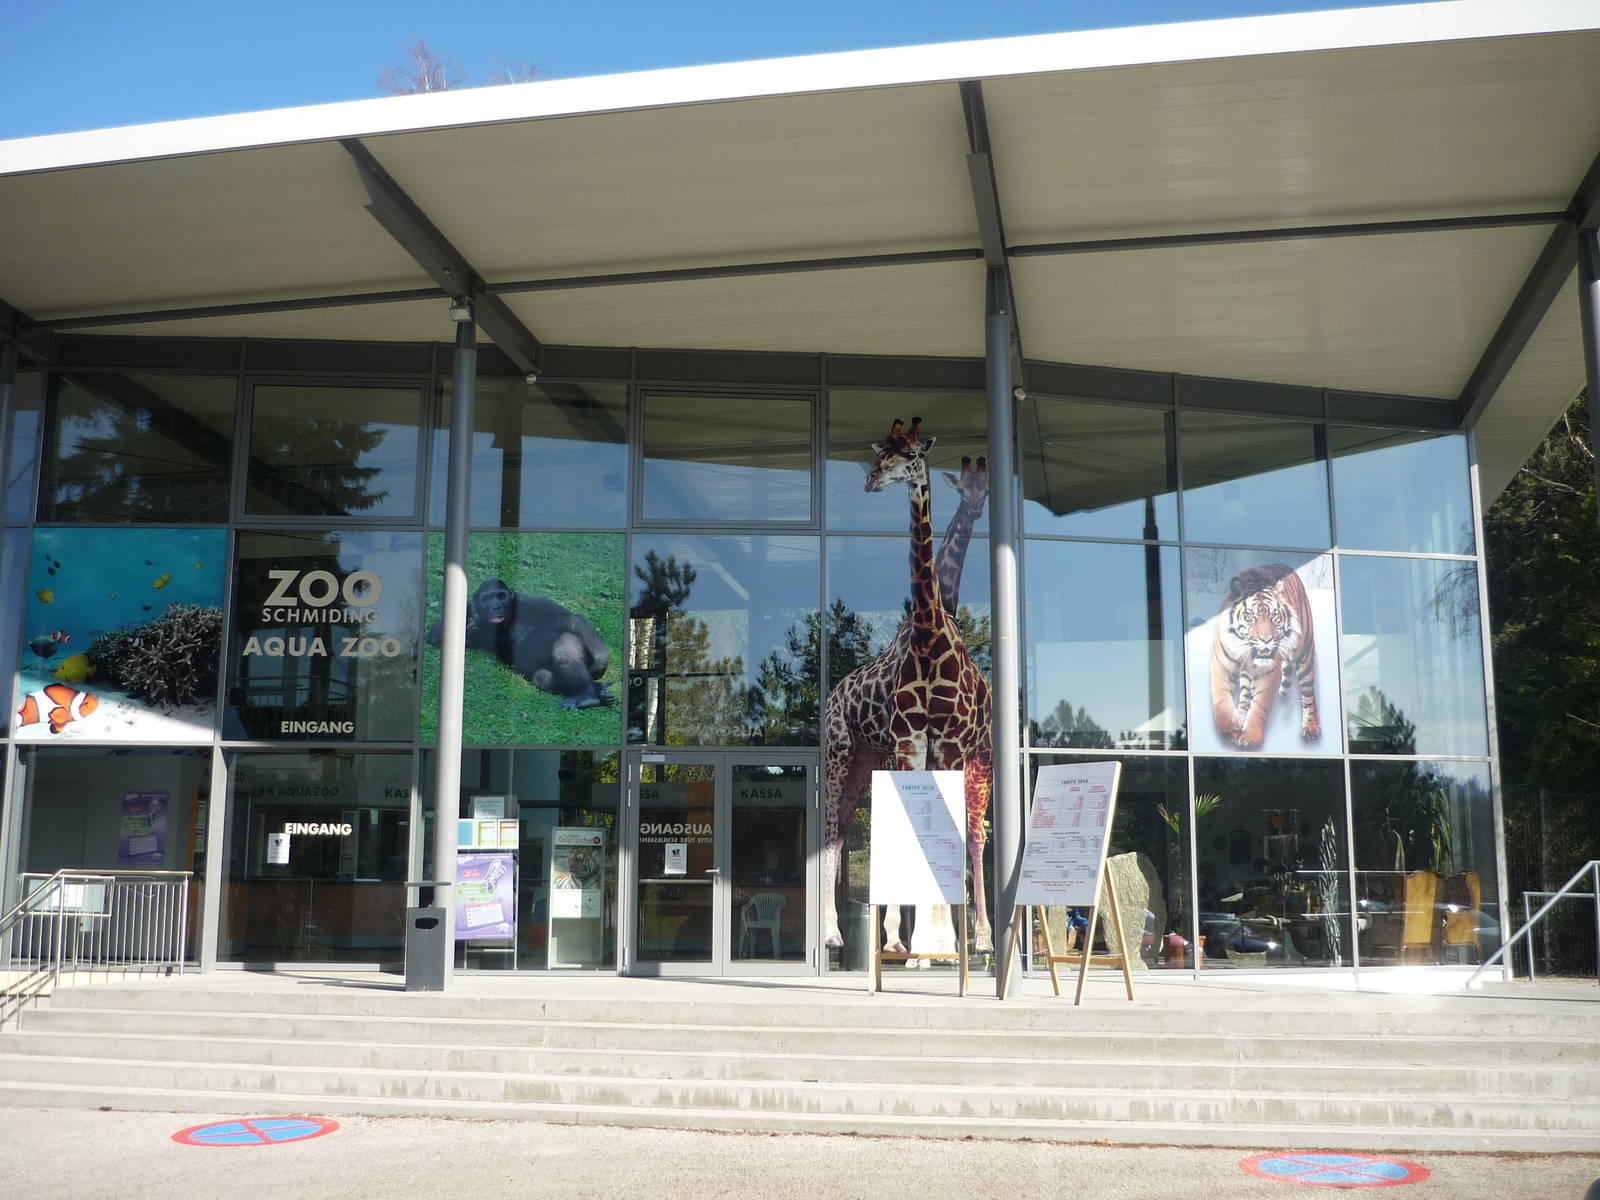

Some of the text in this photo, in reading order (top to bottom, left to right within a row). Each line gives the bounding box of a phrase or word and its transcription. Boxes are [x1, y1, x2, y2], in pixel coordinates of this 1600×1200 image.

[263, 570, 382, 607] ZOO
[262, 608, 380, 624] SCHMIDING
[243, 637, 401, 657] AQUA ZOO
[281, 721, 354, 733] EINGANG
[278, 787, 340, 797] AQUAZOO
[384, 788, 410, 798] KAS
[639, 789, 660, 799] SSA
[741, 788, 783, 799] KASSA
[285, 822, 353, 835] EINGANG
